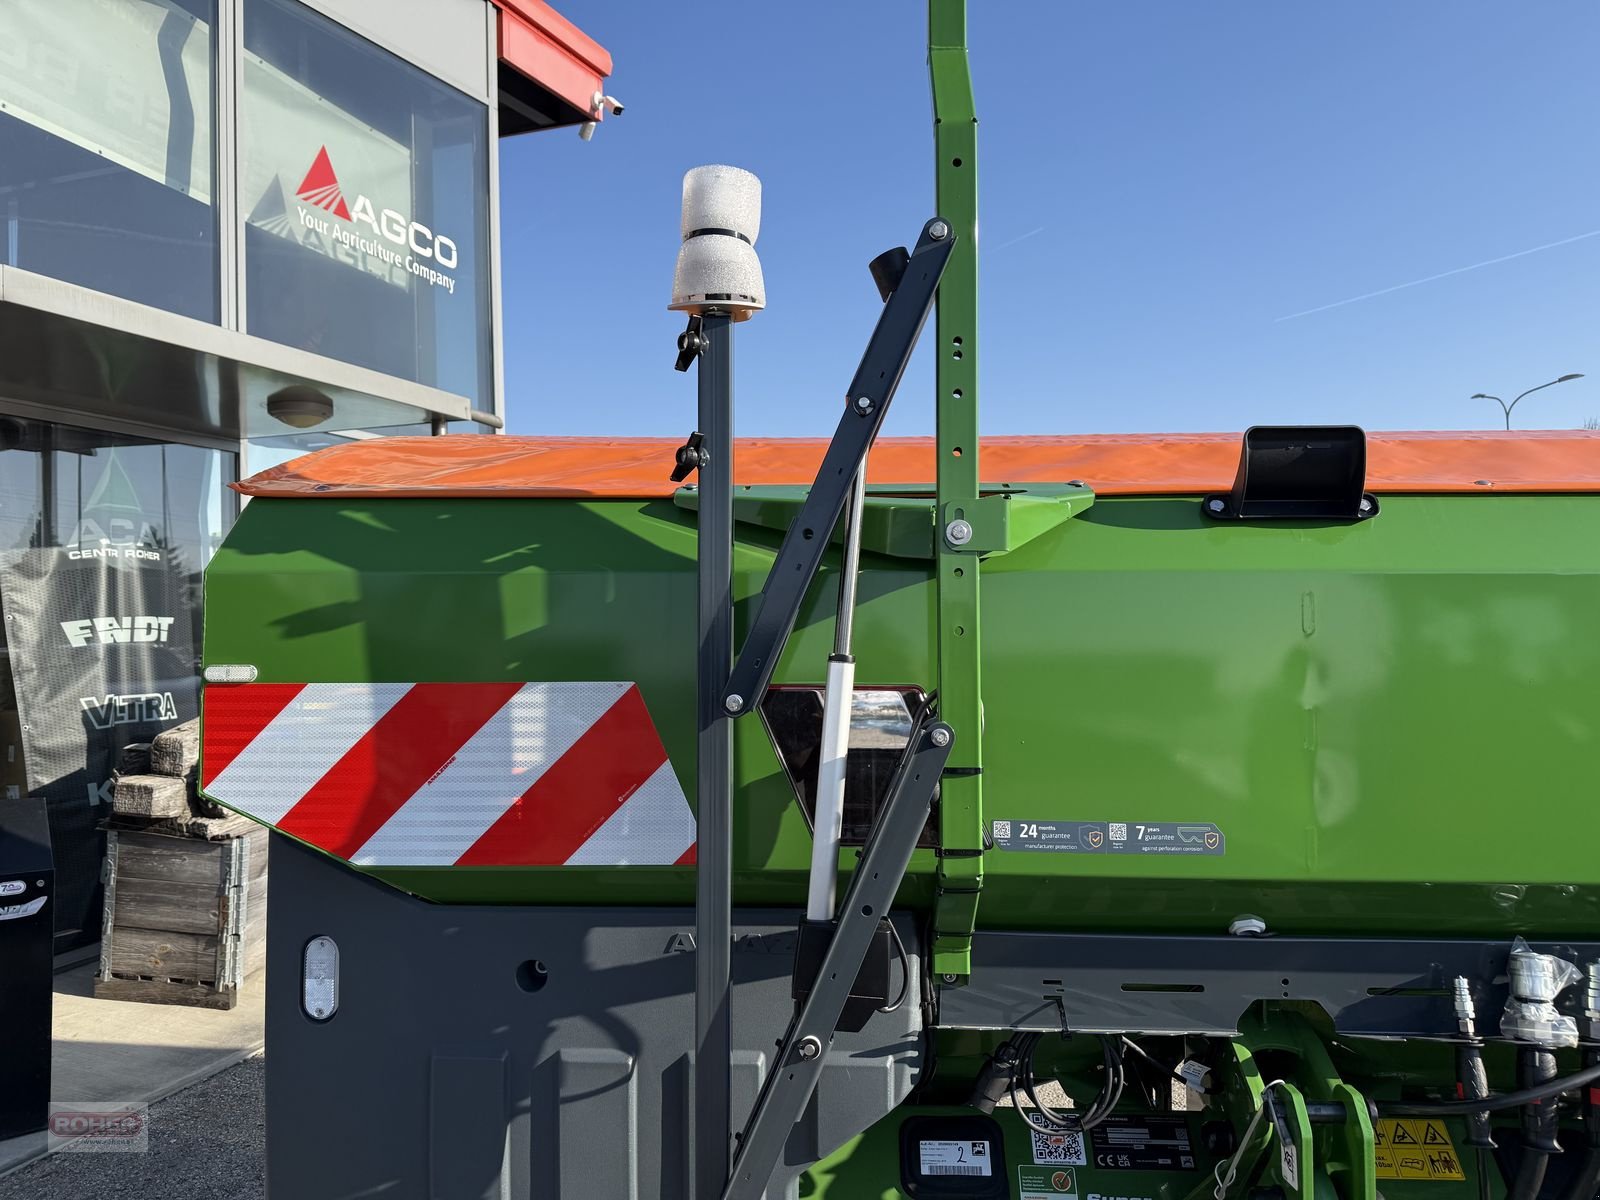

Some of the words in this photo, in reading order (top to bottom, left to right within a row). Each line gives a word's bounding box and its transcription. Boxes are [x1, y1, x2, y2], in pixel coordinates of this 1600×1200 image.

[351, 194, 458, 269] AGCO
[297, 206, 329, 235] Your
[332, 223, 402, 268] Agriculture
[405, 255, 456, 294] Company
[66, 518, 158, 548] ACA
[68, 548, 118, 560] CENTR
[80, 692, 178, 730] VLTRA
[1019, 823, 1038, 838] 24
[1041, 832, 1071, 840] guarantee
[1135, 825, 1146, 840] 7
[957, 1146, 967, 1163] 2
[1097, 1154, 1115, 1167] CE
